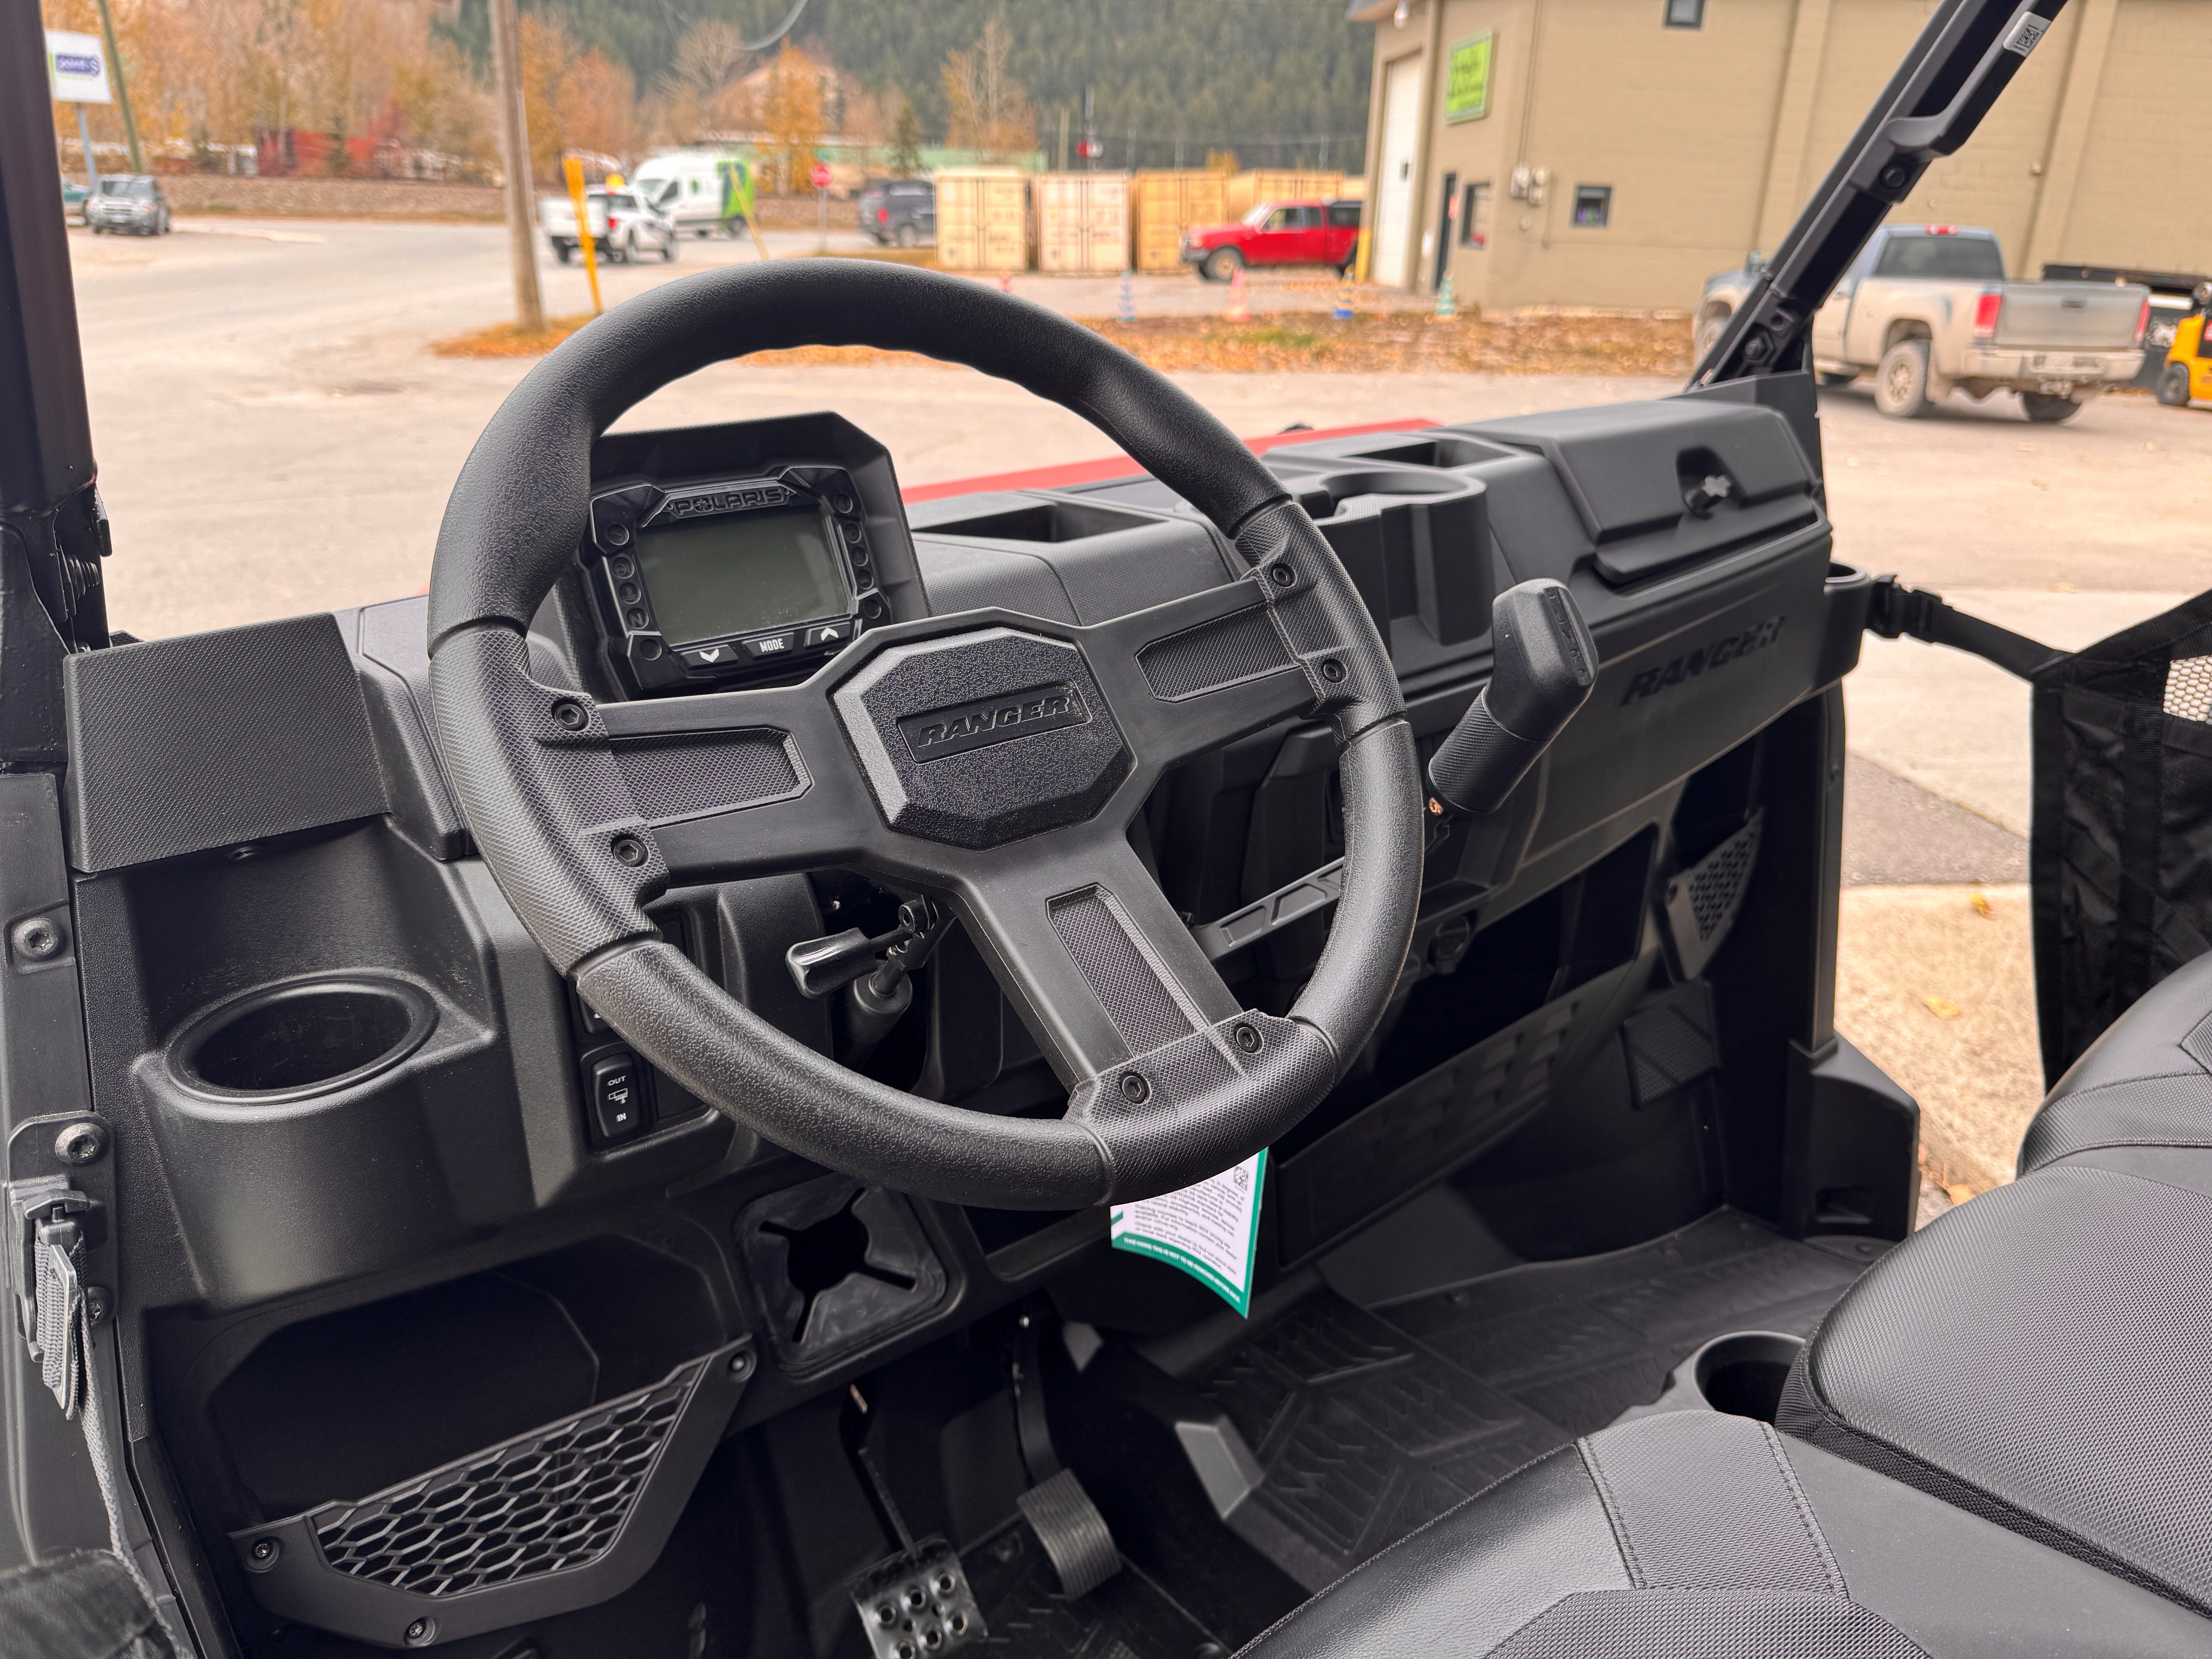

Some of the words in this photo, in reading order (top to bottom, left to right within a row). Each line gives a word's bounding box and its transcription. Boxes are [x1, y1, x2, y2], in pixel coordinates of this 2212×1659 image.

[674, 488, 784, 515] POLARIS
[759, 638, 785, 653] MODE
[1620, 615, 1785, 706] RANGER
[918, 696, 1070, 747] RANGER
[607, 1075, 626, 1086] OUT
[616, 1113, 627, 1122] IN
